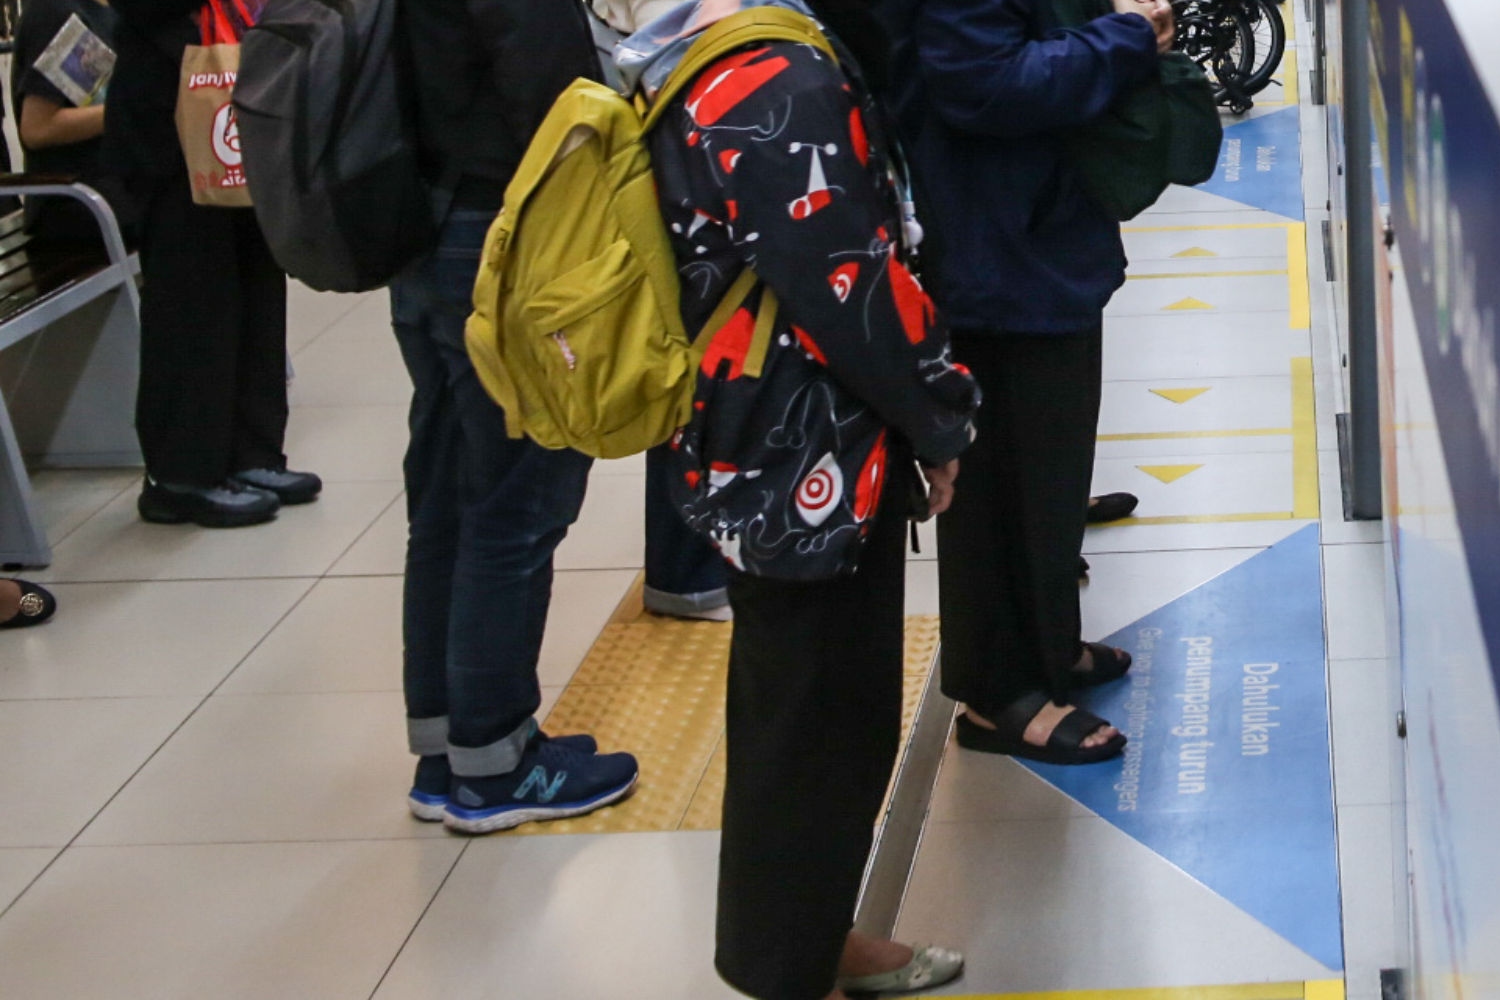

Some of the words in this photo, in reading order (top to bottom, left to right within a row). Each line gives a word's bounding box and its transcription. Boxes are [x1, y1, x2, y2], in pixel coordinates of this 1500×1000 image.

[1132, 653, 1153, 673] way
[1137, 626, 1163, 650] Give
[1171, 635, 1213, 737] penumpang
[1240, 661, 1280, 757] Dahulukan
[1177, 741, 1215, 795] turun
